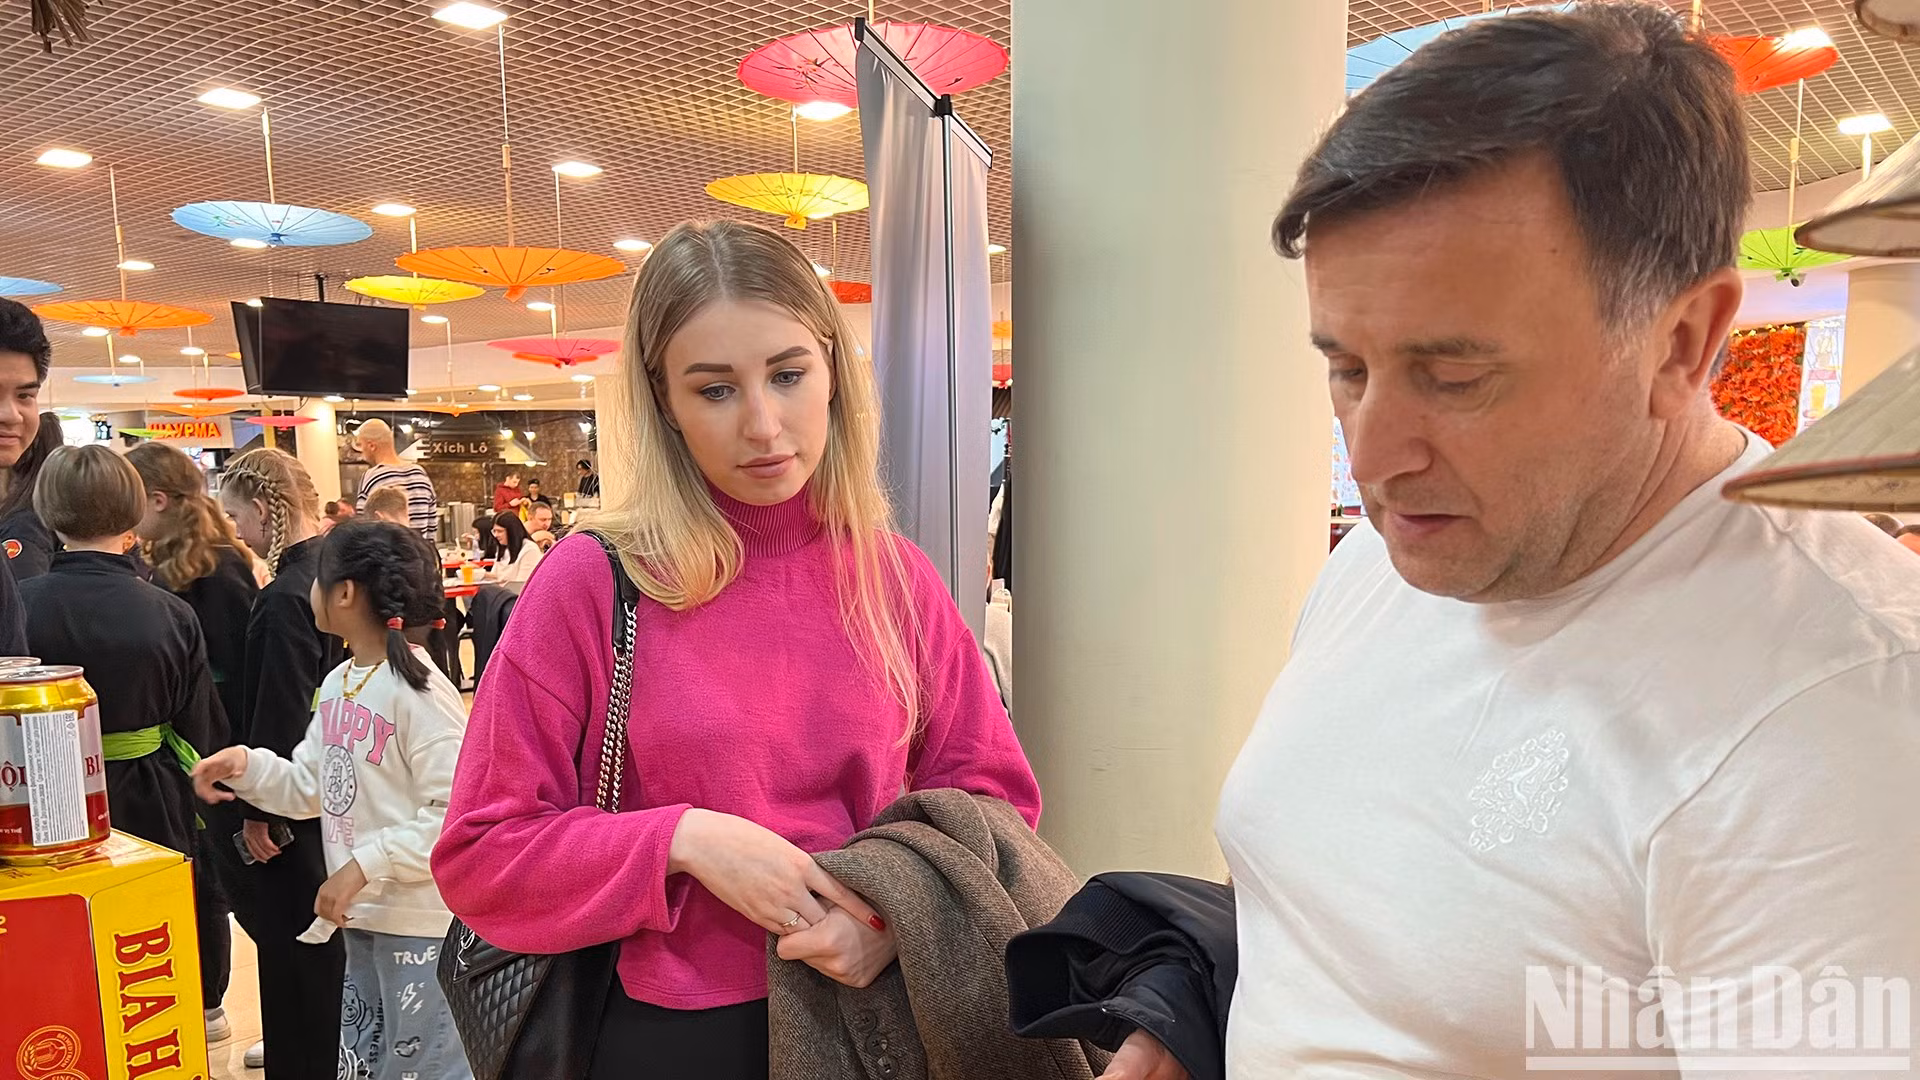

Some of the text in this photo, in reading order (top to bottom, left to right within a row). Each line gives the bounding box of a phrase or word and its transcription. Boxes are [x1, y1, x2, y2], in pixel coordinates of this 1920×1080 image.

[147, 422, 221, 440] ШАУРМА
[433, 441, 488, 454] Xích Lô
[393, 945, 438, 965] TRUE
[113, 920, 178, 1035] BIA
